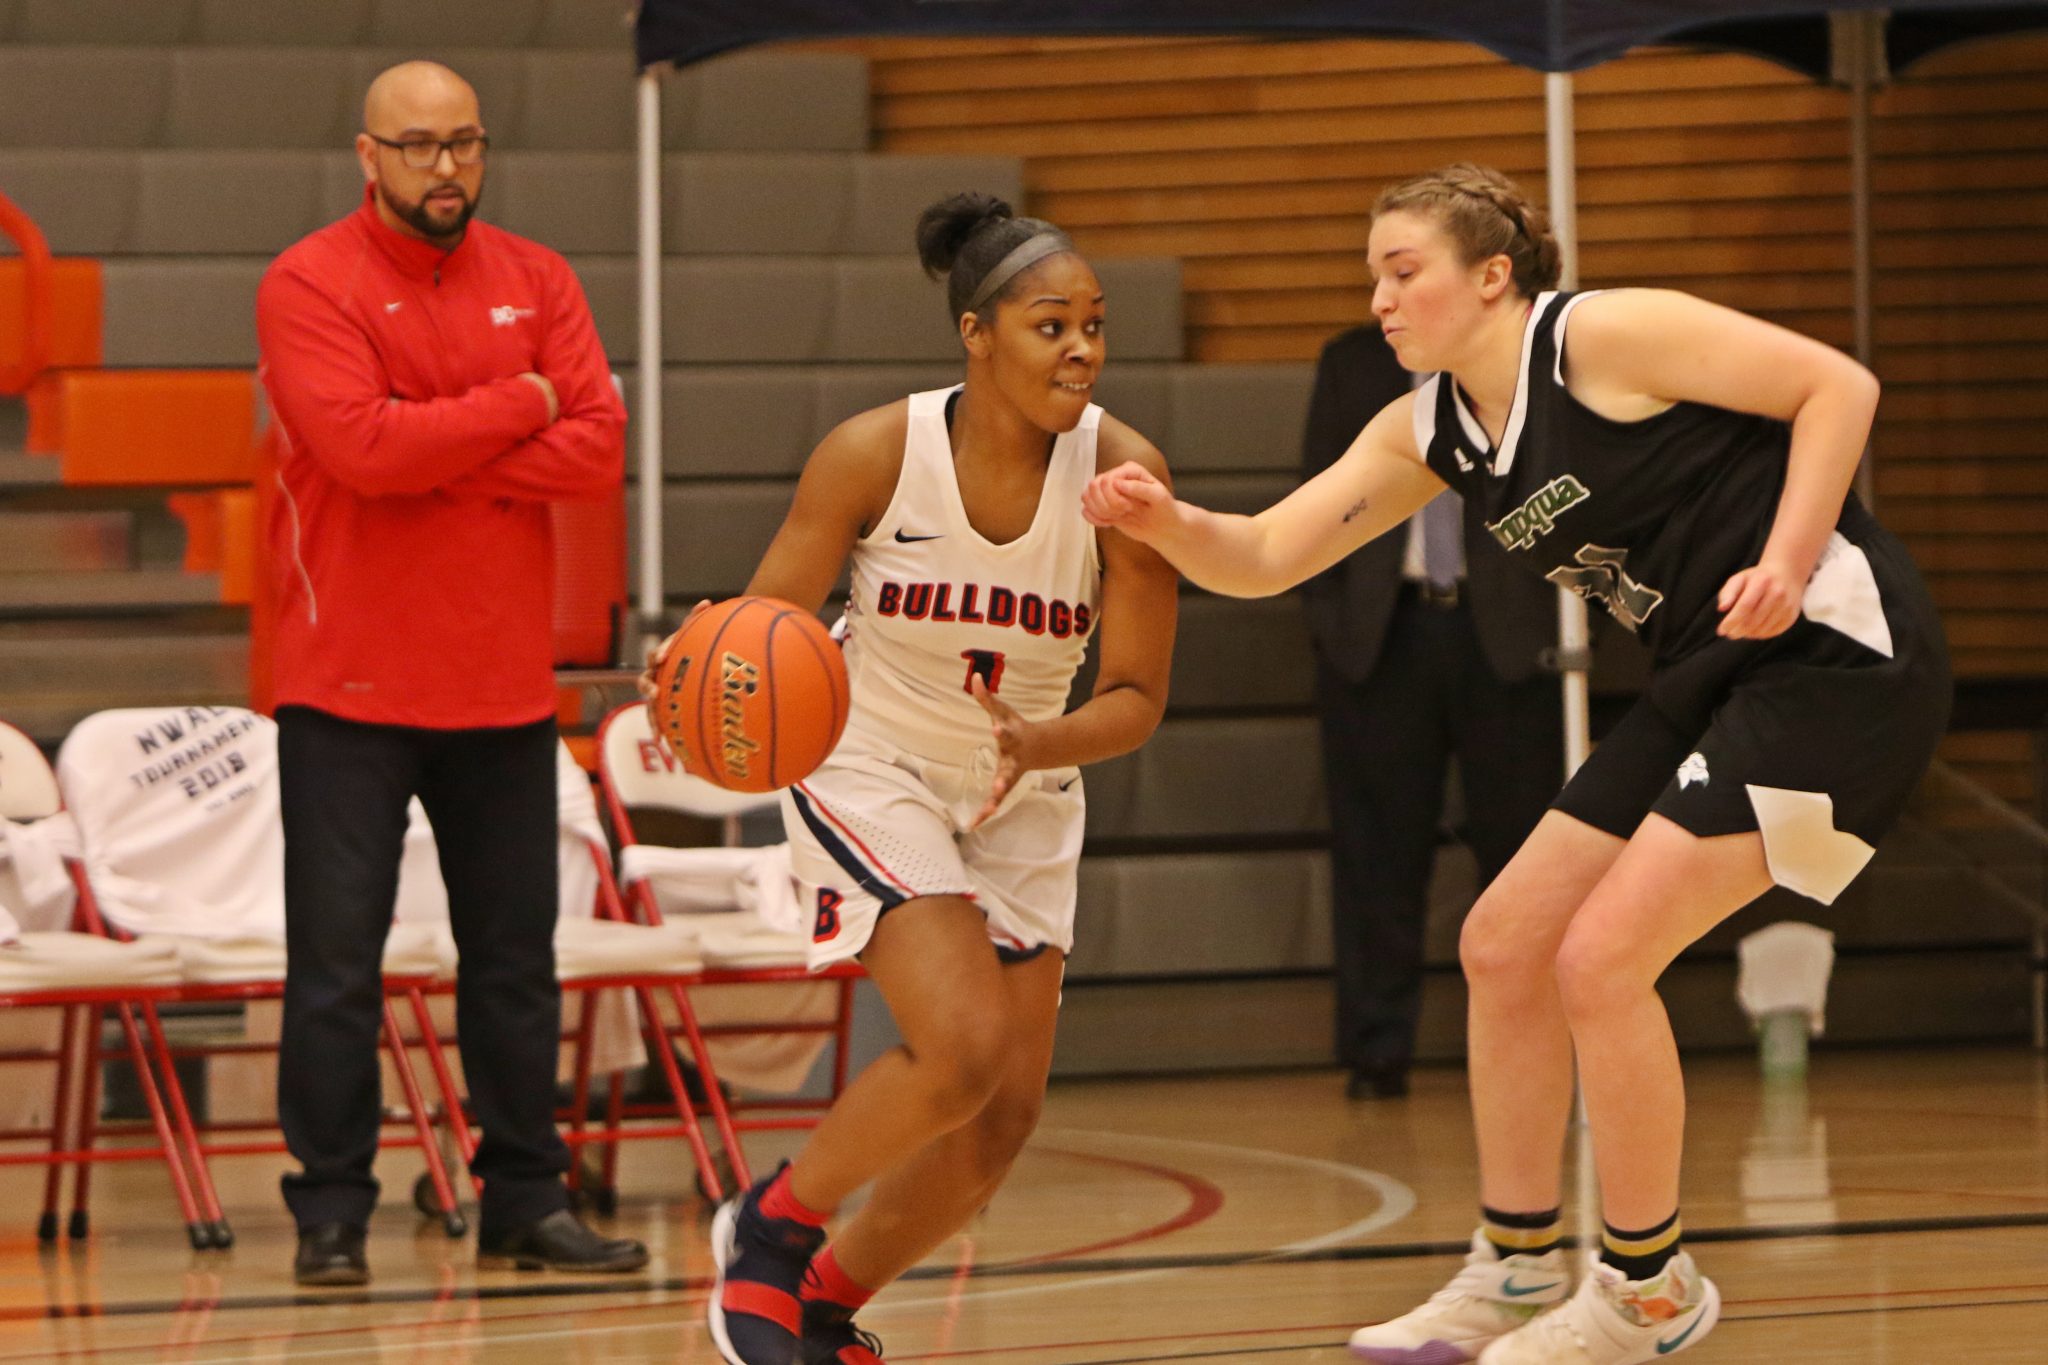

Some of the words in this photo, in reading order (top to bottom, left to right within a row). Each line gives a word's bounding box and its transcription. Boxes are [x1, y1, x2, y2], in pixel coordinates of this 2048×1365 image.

[877, 581, 1091, 639] BULLDOGS
[178, 751, 247, 798] 2018
[813, 886, 845, 944] B
